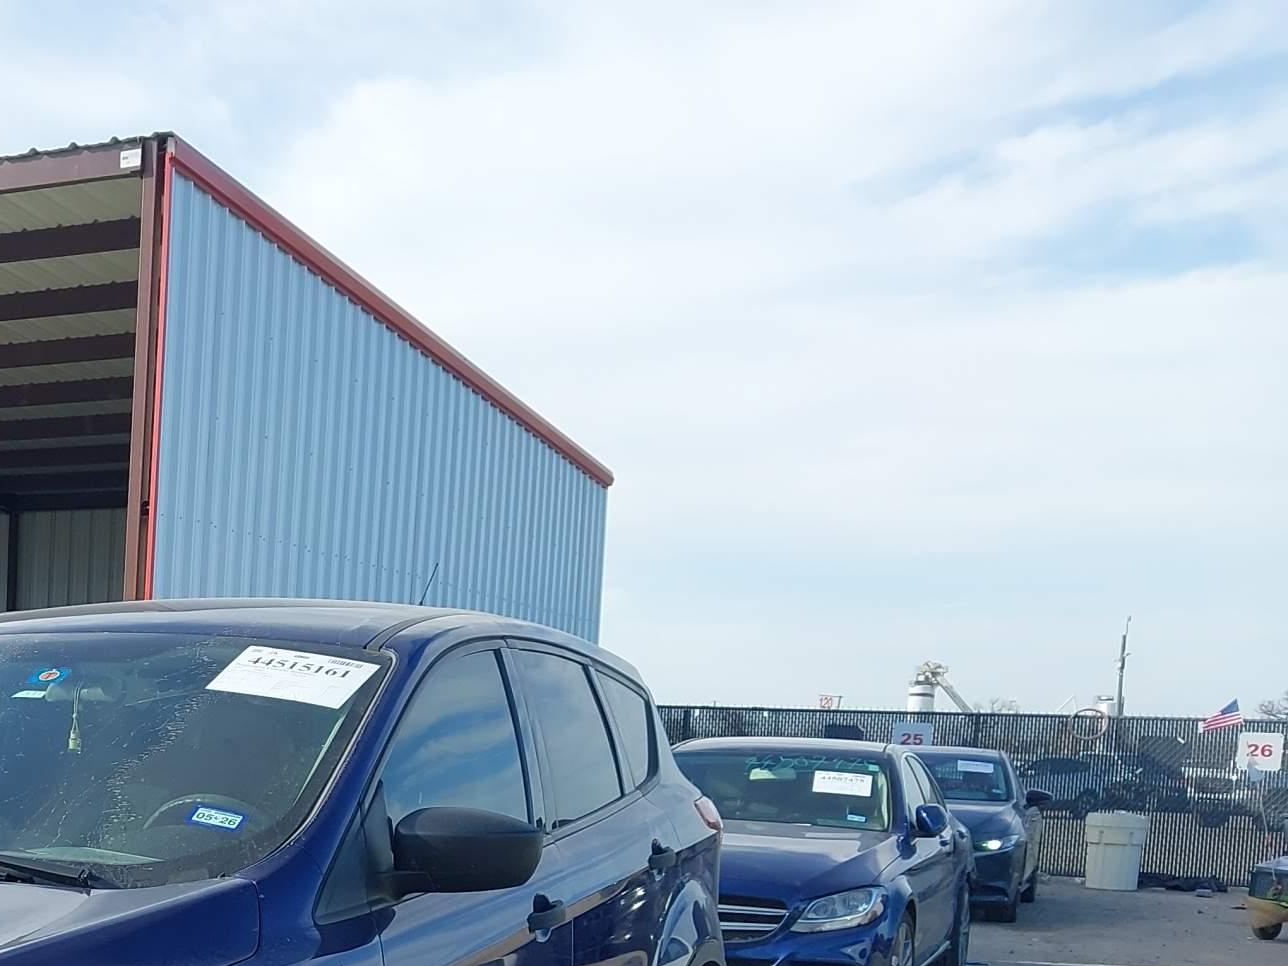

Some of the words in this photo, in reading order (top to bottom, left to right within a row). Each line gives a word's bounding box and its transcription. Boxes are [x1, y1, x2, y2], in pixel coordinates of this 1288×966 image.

[247, 656, 352, 679] 44515161
[900, 732, 924, 746] 25
[1246, 743, 1273, 758] 26
